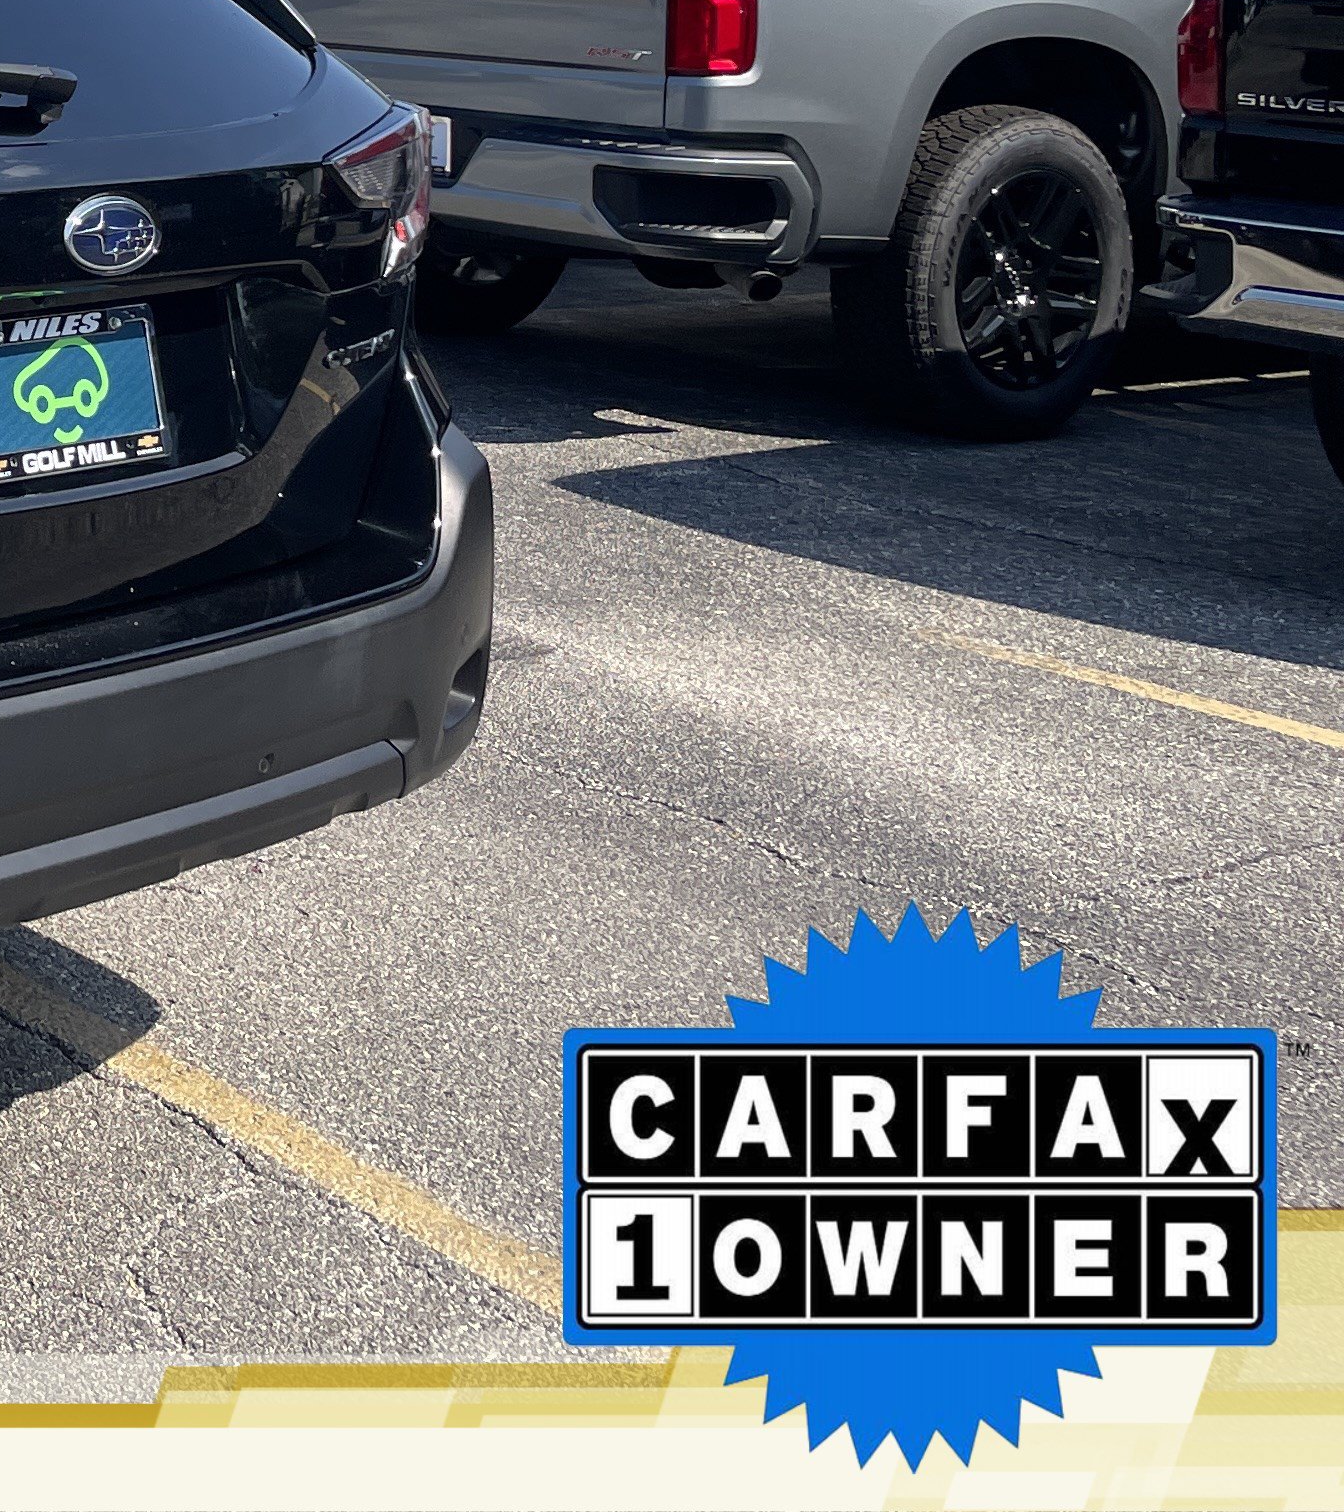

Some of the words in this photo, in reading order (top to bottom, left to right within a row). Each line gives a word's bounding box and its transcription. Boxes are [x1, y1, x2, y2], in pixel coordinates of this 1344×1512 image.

[9, 312, 102, 342] NILES
[21, 446, 76, 474] GOLF
[76, 440, 127, 466] MILL
